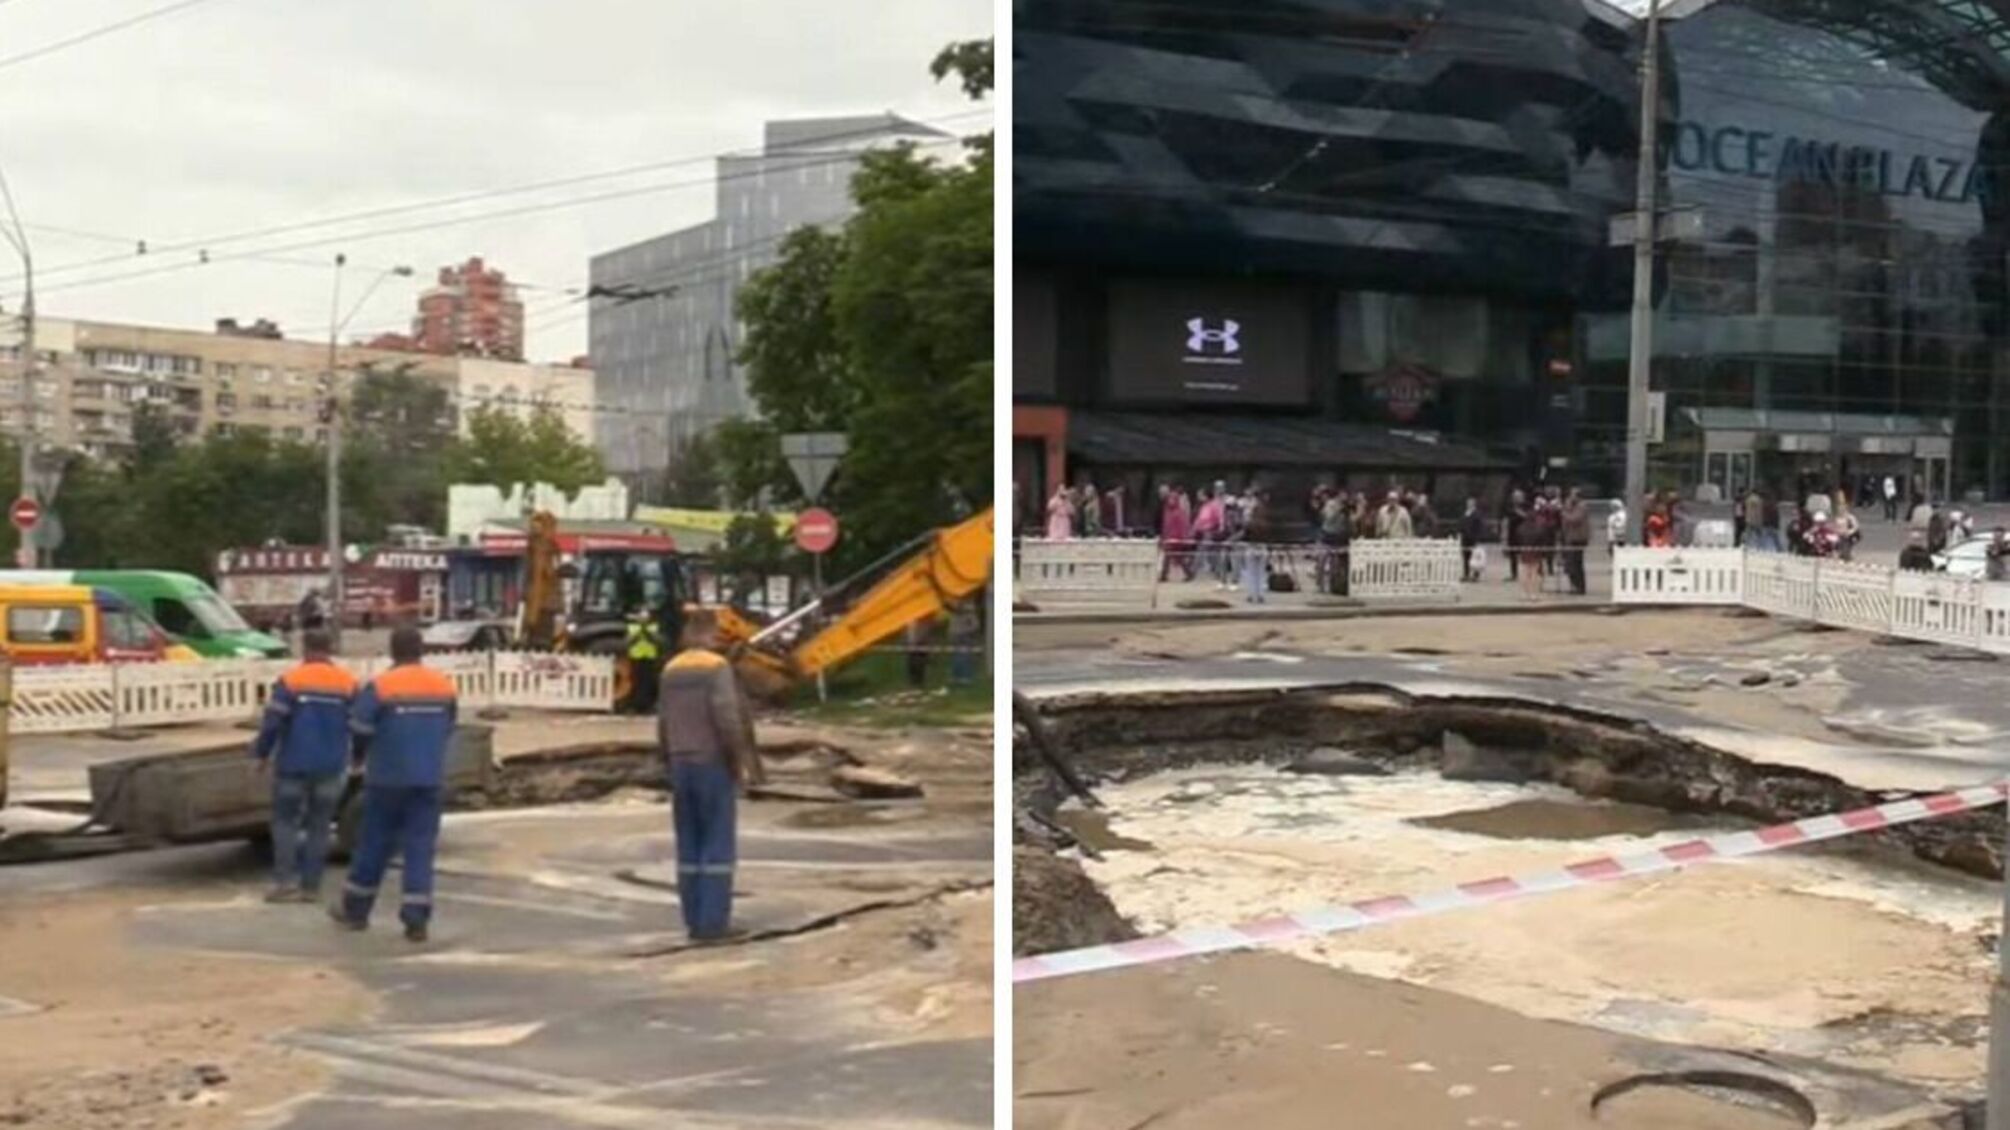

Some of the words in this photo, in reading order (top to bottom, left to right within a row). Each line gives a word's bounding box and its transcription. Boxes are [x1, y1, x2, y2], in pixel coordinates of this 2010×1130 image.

[1672, 120, 1838, 185] OCEAN
[1844, 144, 1990, 204] PLAZA
[374, 552, 448, 569] АПТЕКА
